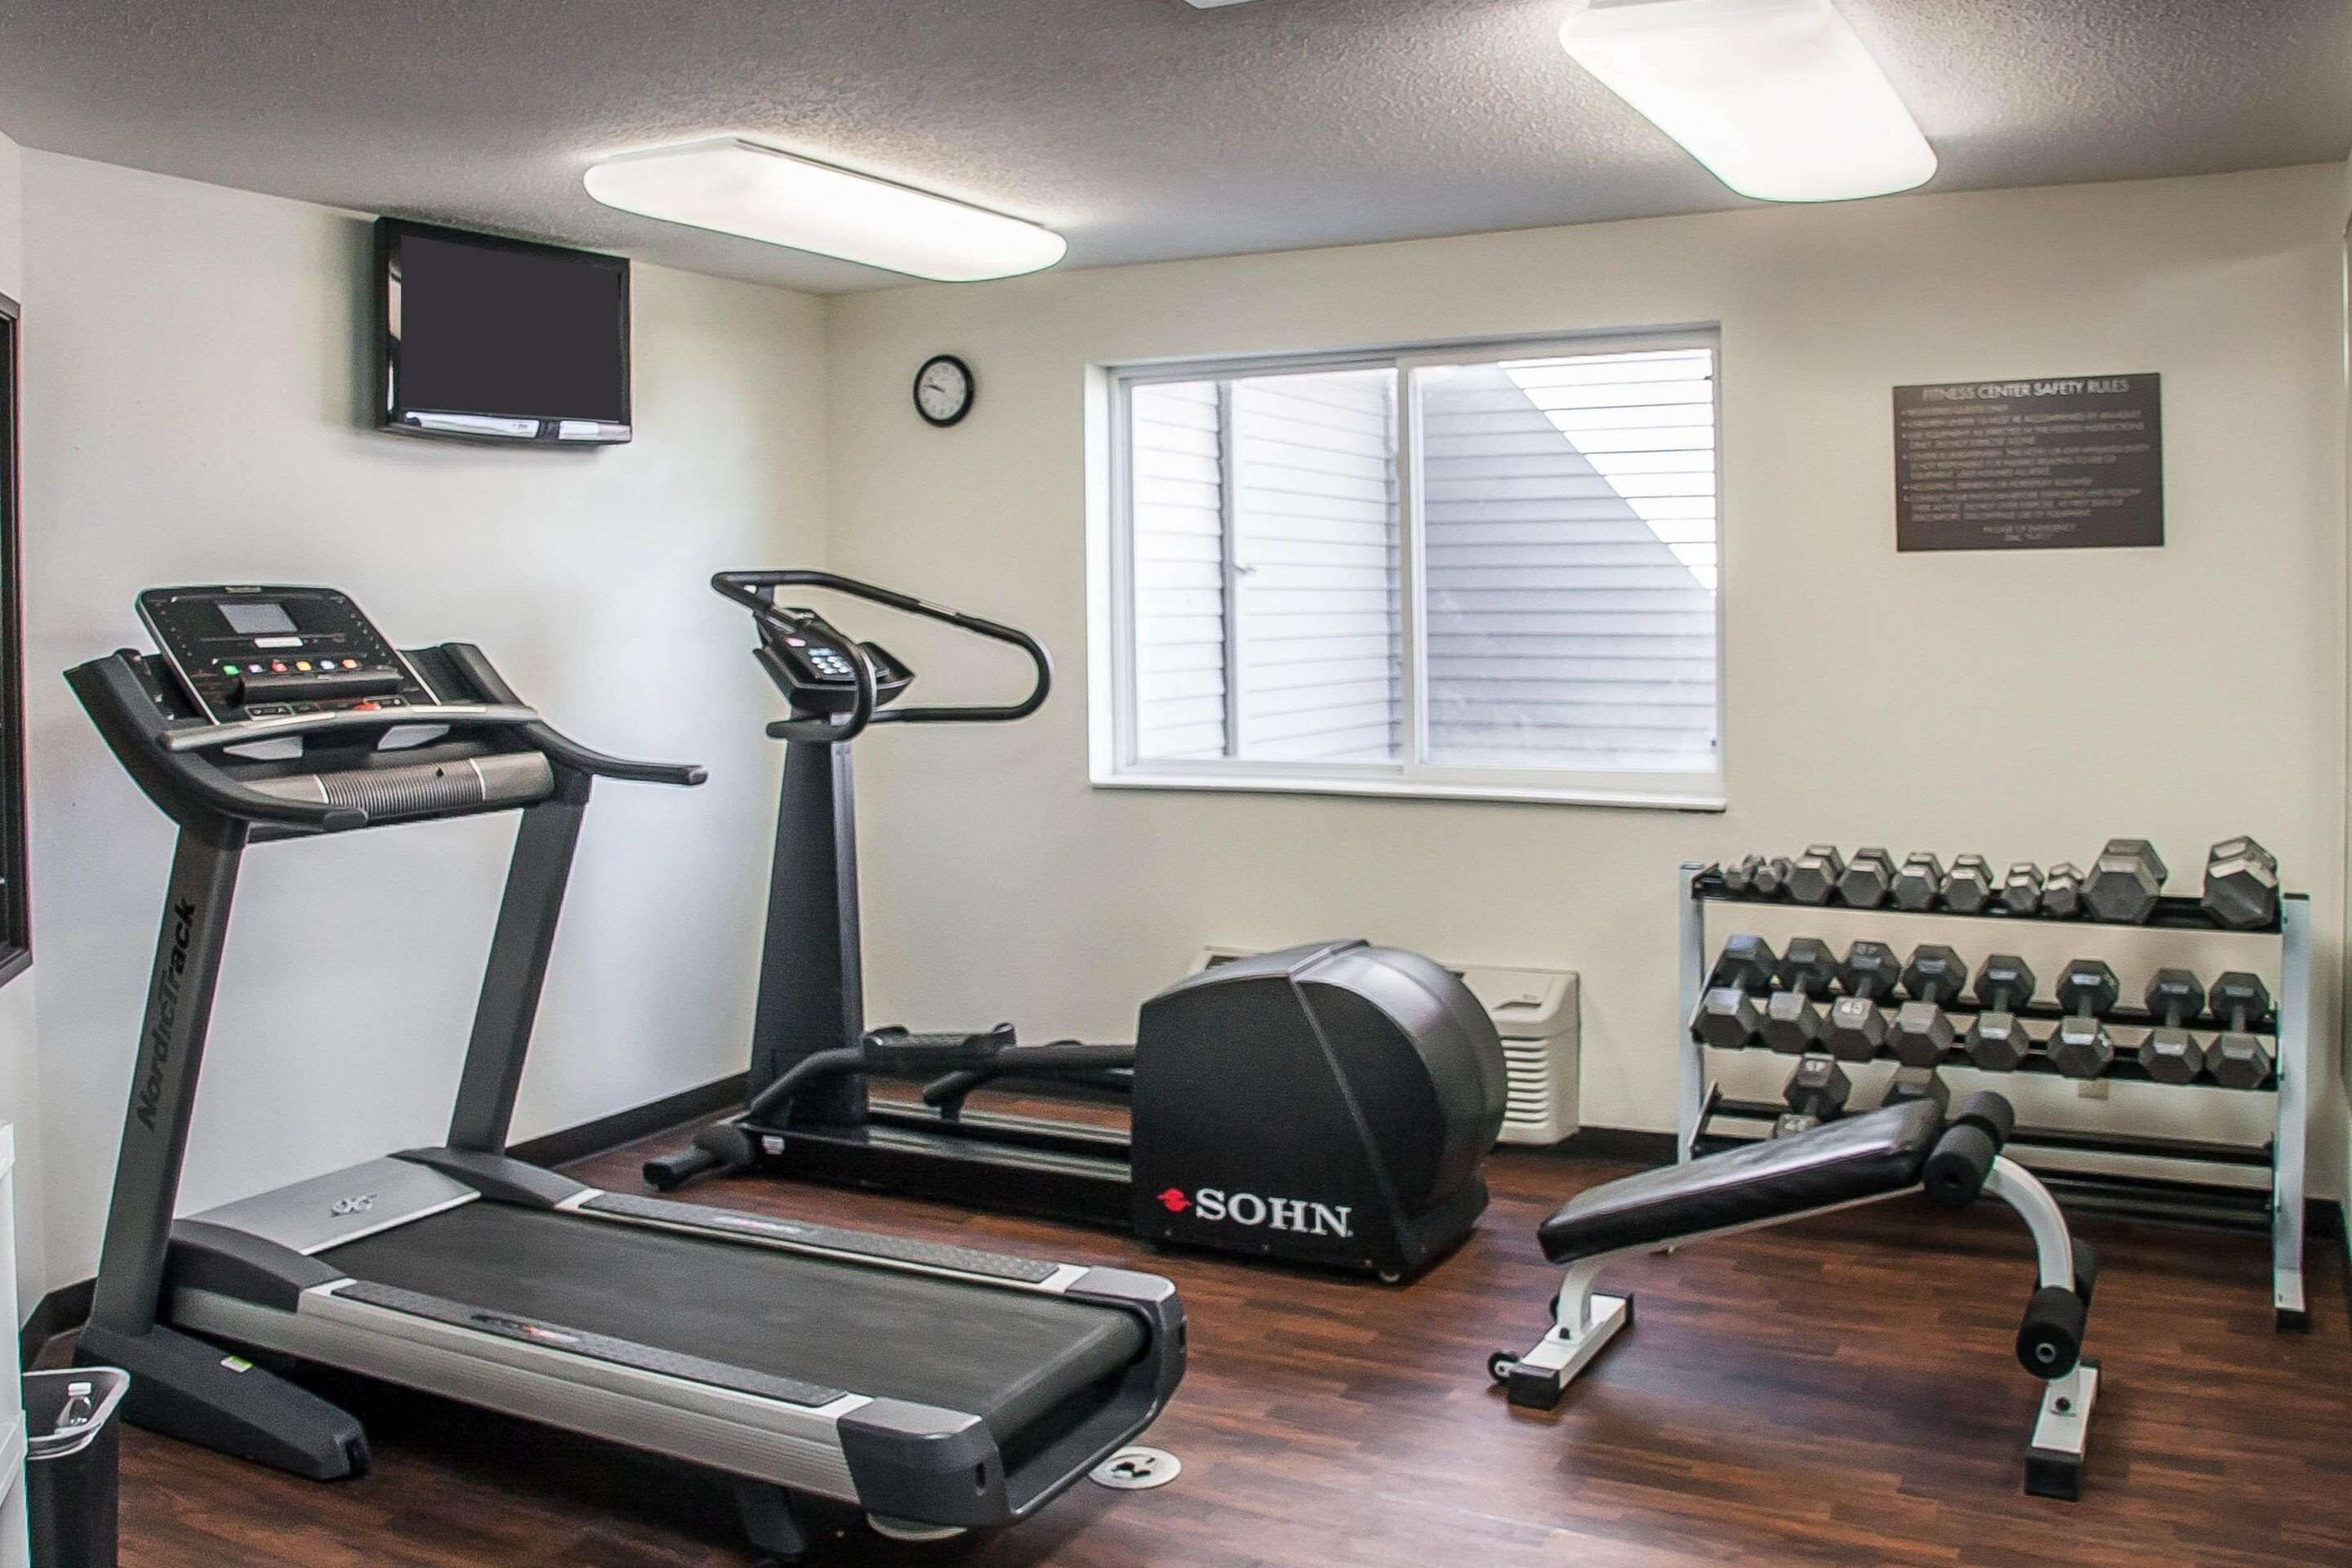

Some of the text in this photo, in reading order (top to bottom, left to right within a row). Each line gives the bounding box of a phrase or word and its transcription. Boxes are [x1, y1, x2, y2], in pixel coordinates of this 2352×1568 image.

[1922, 377, 2129, 402] FITNESS CENTER SAFETY RULES
[136, 898, 196, 1133] NordicTrack
[1196, 1187, 1353, 1237] SOHN
